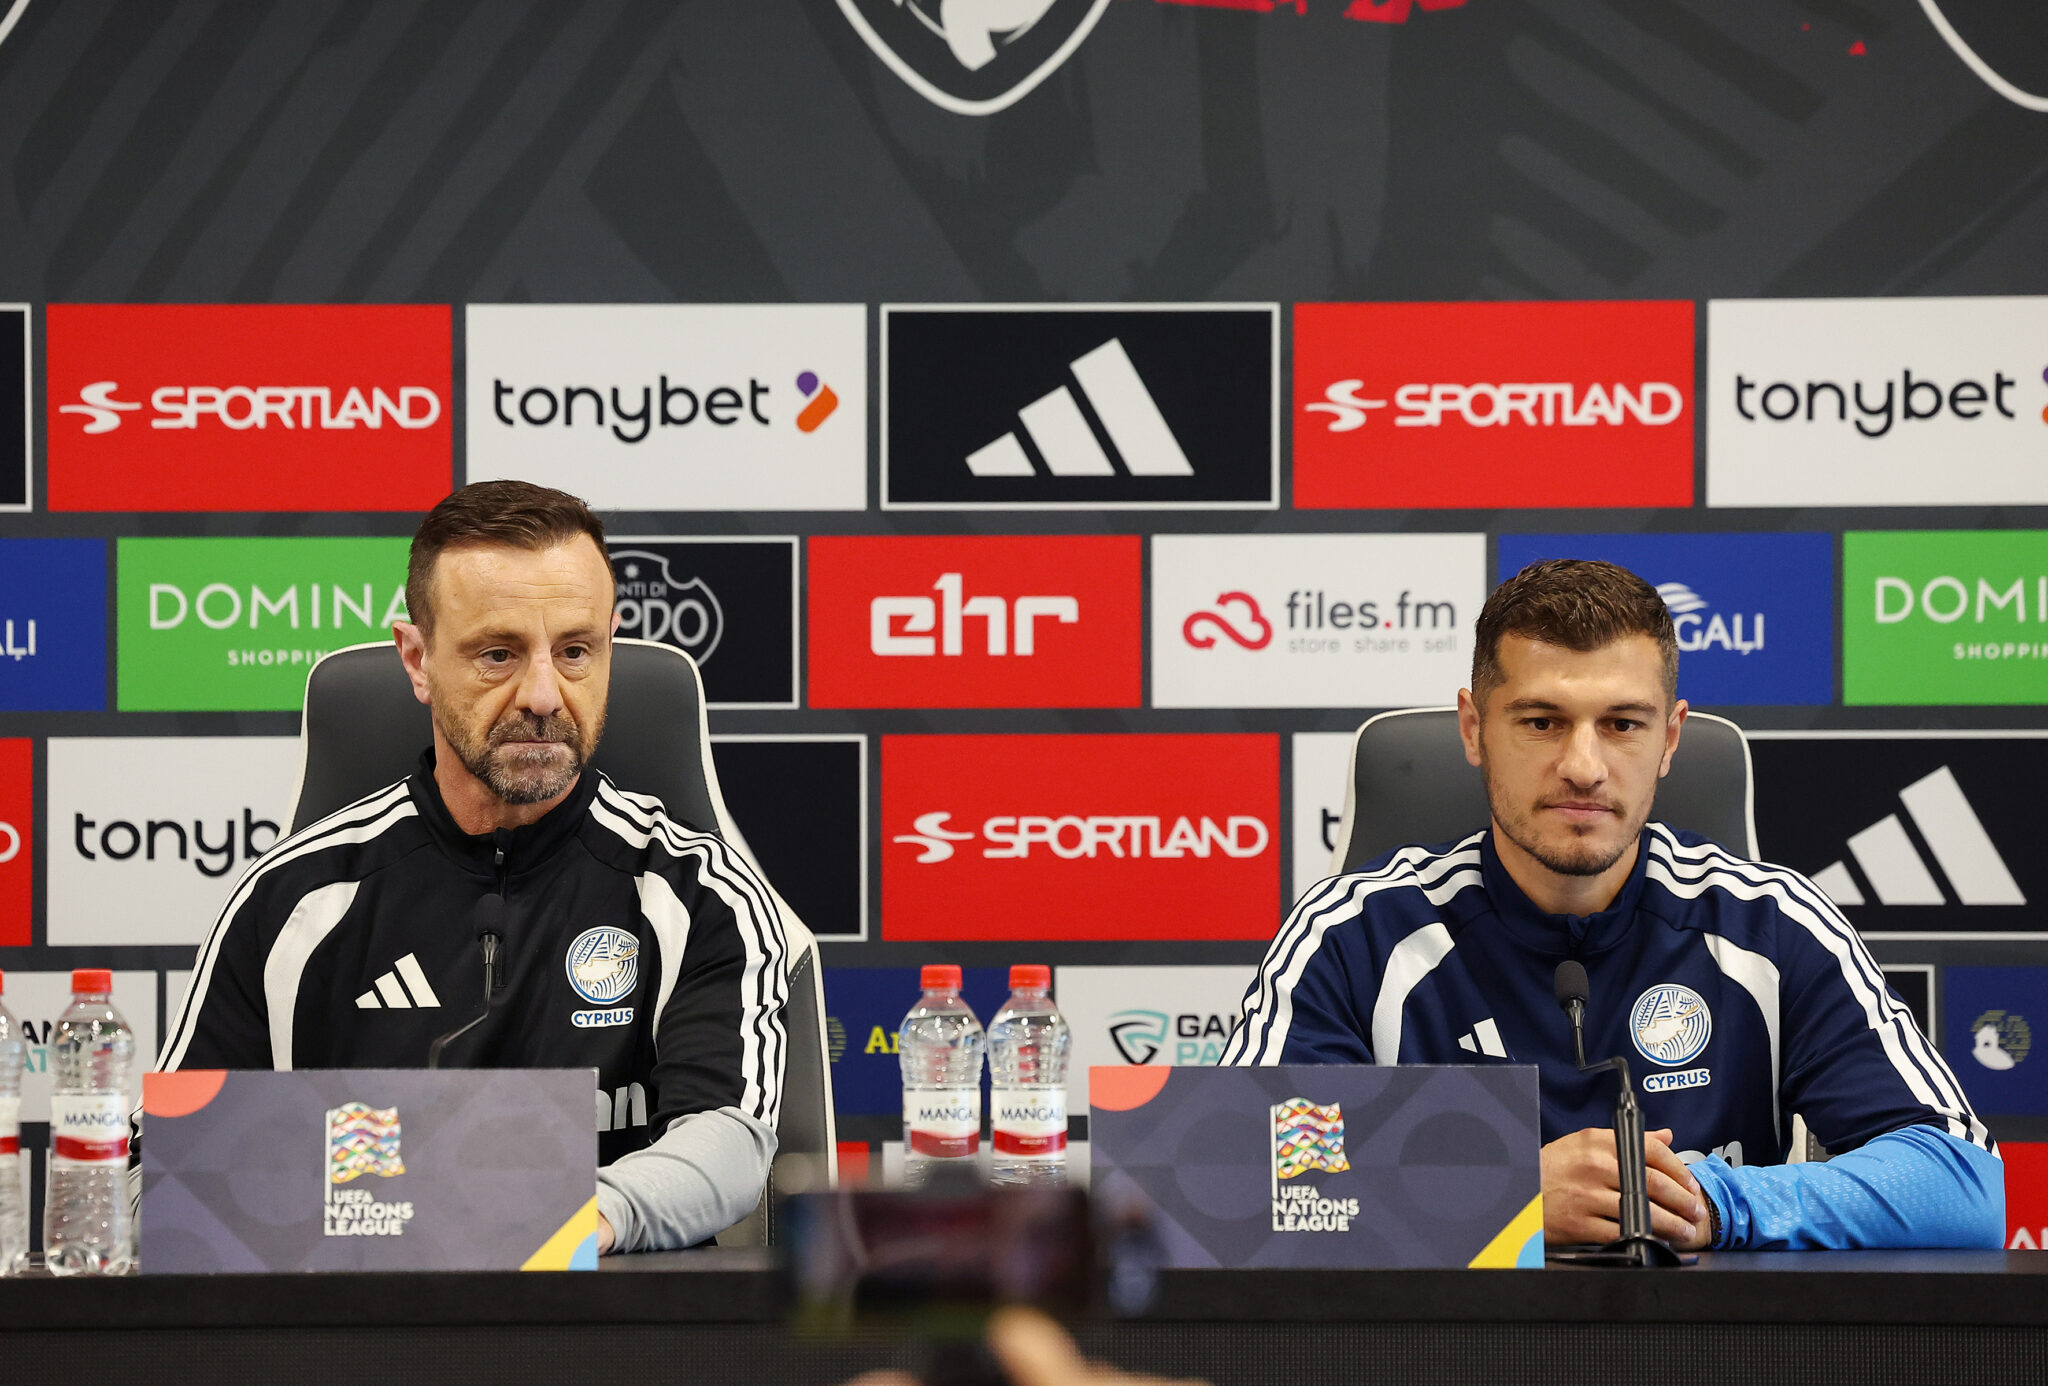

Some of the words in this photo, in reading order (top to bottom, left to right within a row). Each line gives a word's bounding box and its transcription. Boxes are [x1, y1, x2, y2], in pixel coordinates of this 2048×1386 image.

[151, 386, 440, 429] SPORTLAND
[494, 374, 769, 443] tonybet
[1394, 382, 1683, 427] SPORTLAND
[1736, 368, 2015, 437] tonybet
[1286, 591, 1456, 629] files.fm
[1875, 575, 2048, 624] DOMI
[870, 572, 1079, 656] ehr
[1288, 636, 1340, 652] store
[1354, 636, 1410, 652] share
[1423, 636, 1457, 652] sell
[75, 808, 281, 877] tonyb
[983, 816, 1269, 859] SPORTLAND
[573, 1009, 633, 1026] CYPRUS
[1177, 1042, 1226, 1066] PA
[1645, 1070, 1710, 1090] CYPRUS
[333, 1189, 374, 1204] UEFA
[1280, 1185, 1320, 1199] UEFA
[324, 1202, 414, 1220] NATIONS
[1272, 1198, 1360, 1216] NATIONS
[324, 1220, 403, 1236] LEAGUE
[1272, 1216, 1350, 1232] LEAGUE
